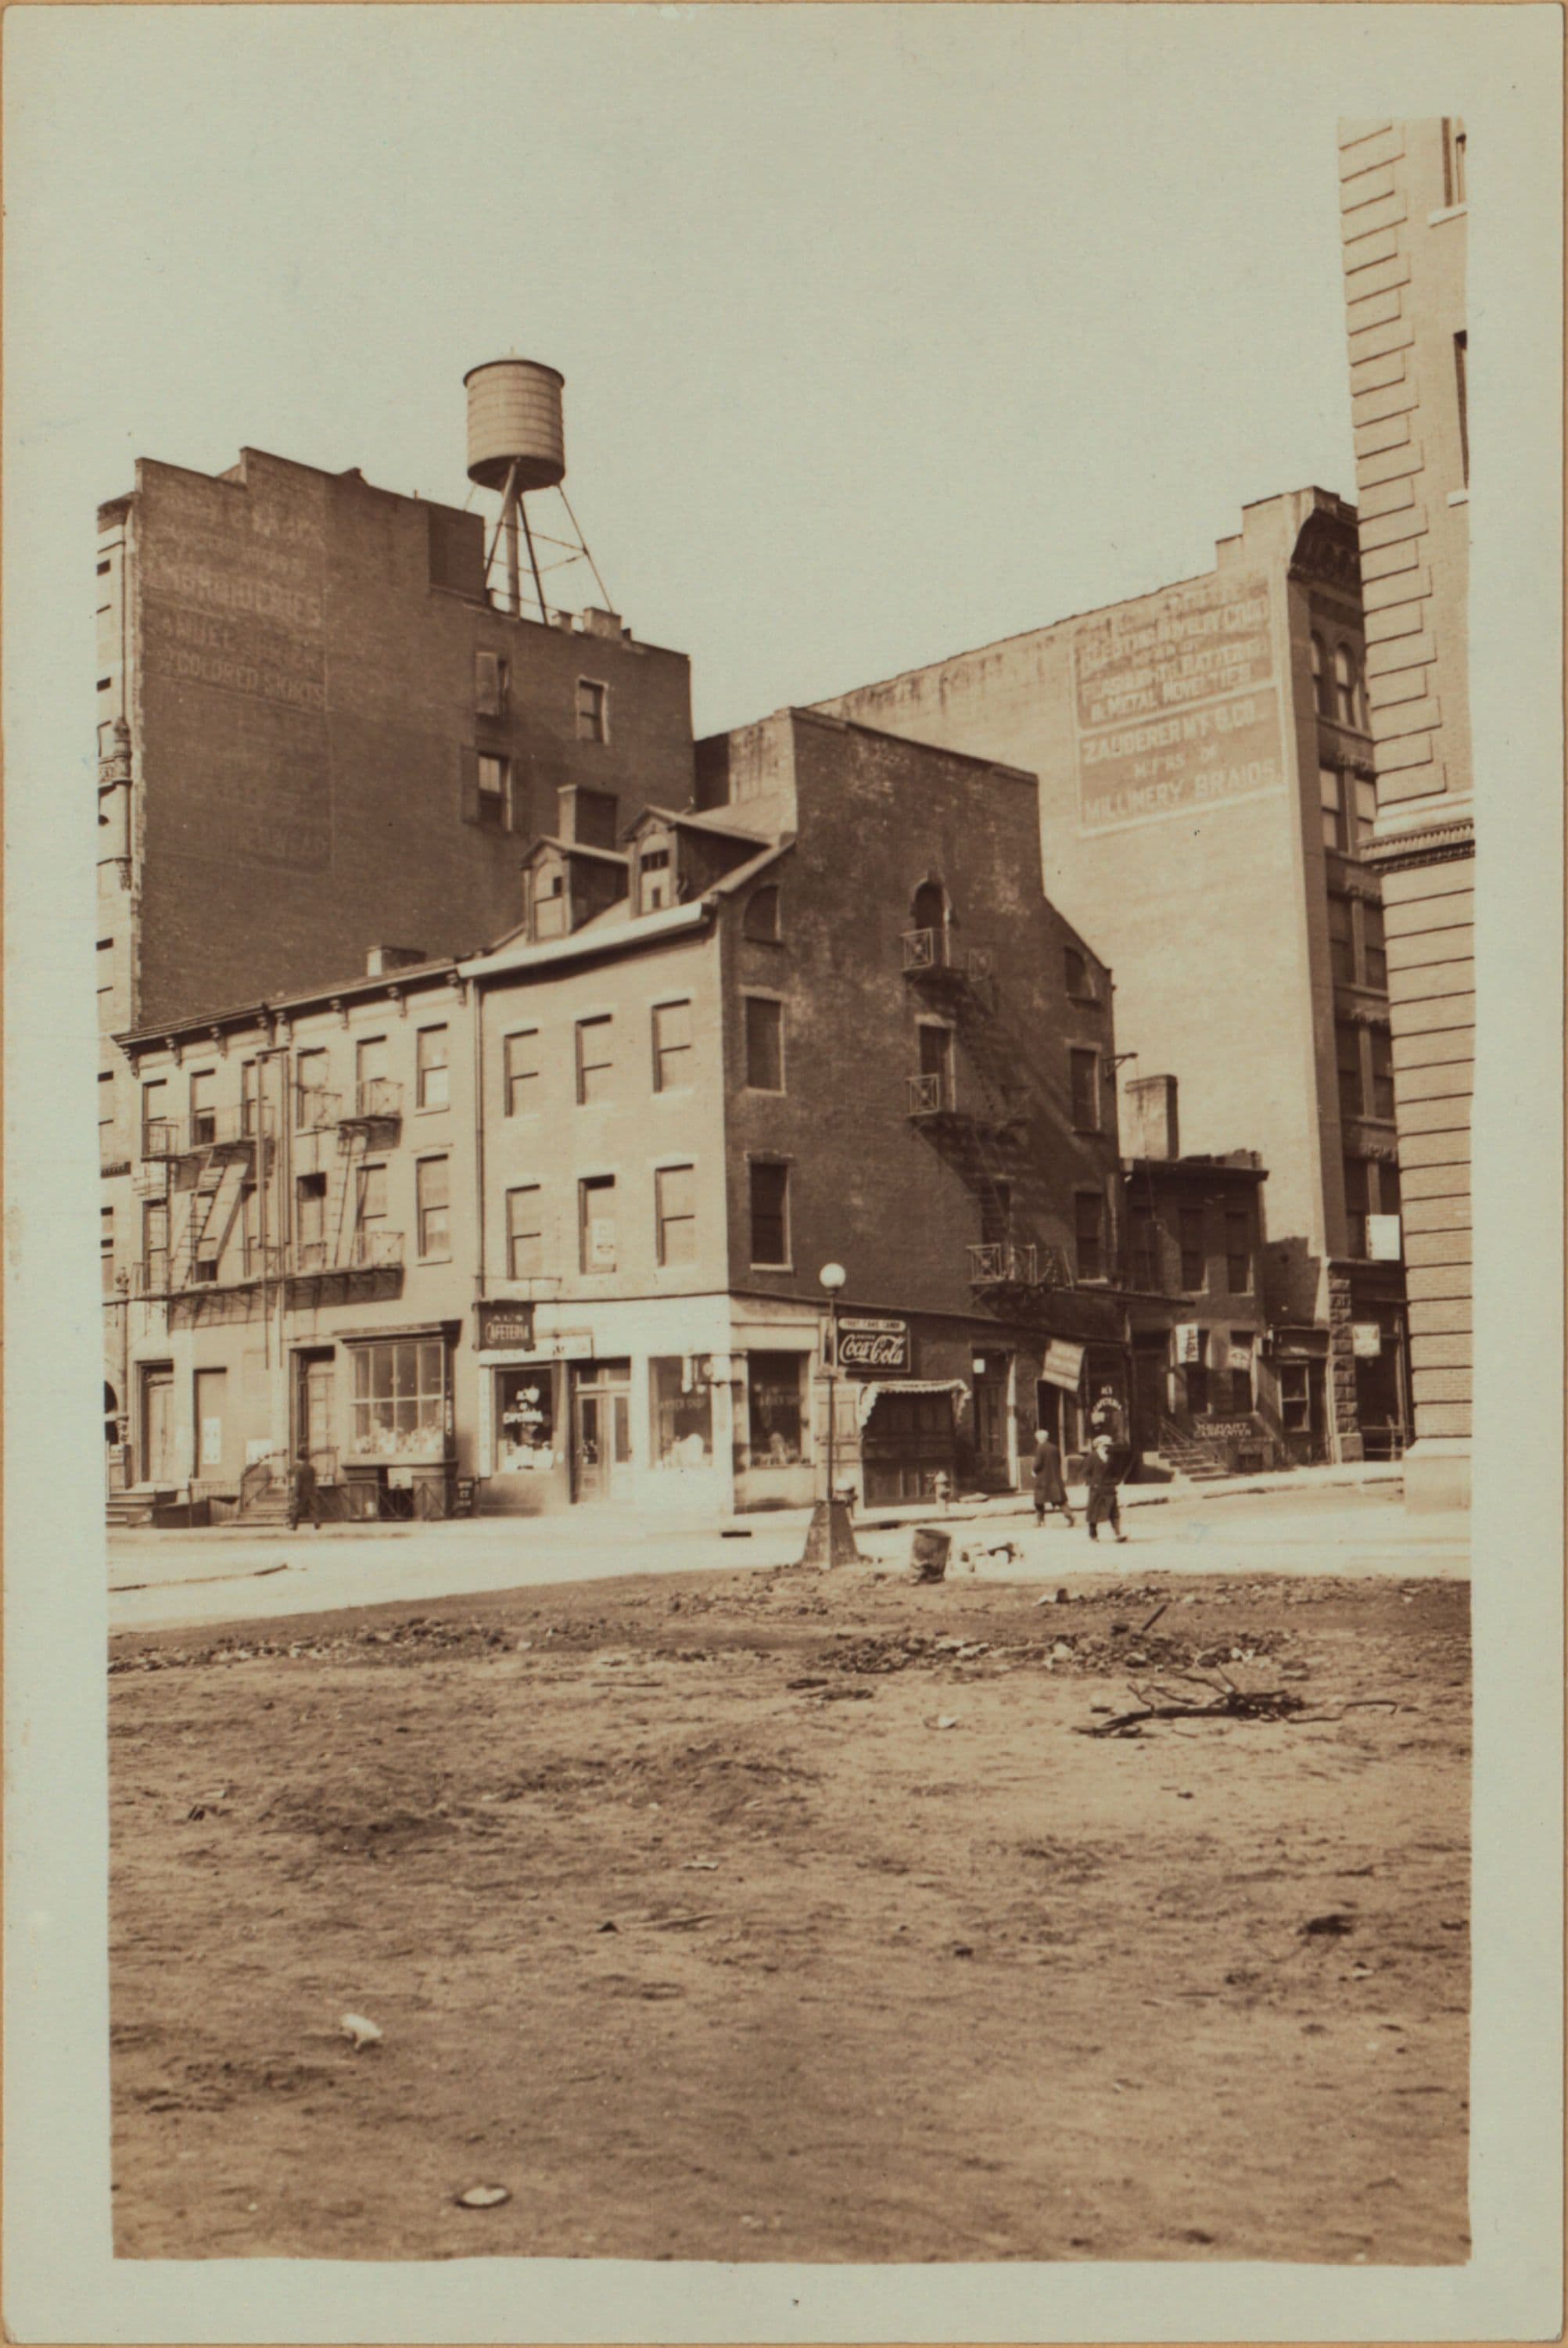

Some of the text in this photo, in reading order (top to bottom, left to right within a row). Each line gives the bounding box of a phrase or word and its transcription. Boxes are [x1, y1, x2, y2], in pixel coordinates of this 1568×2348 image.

[1084, 760, 1276, 820] MILLINERY BRAIDS
[485, 1322, 529, 1344] CAFETERIA
[839, 1334, 906, 1365] Coca-Cola
